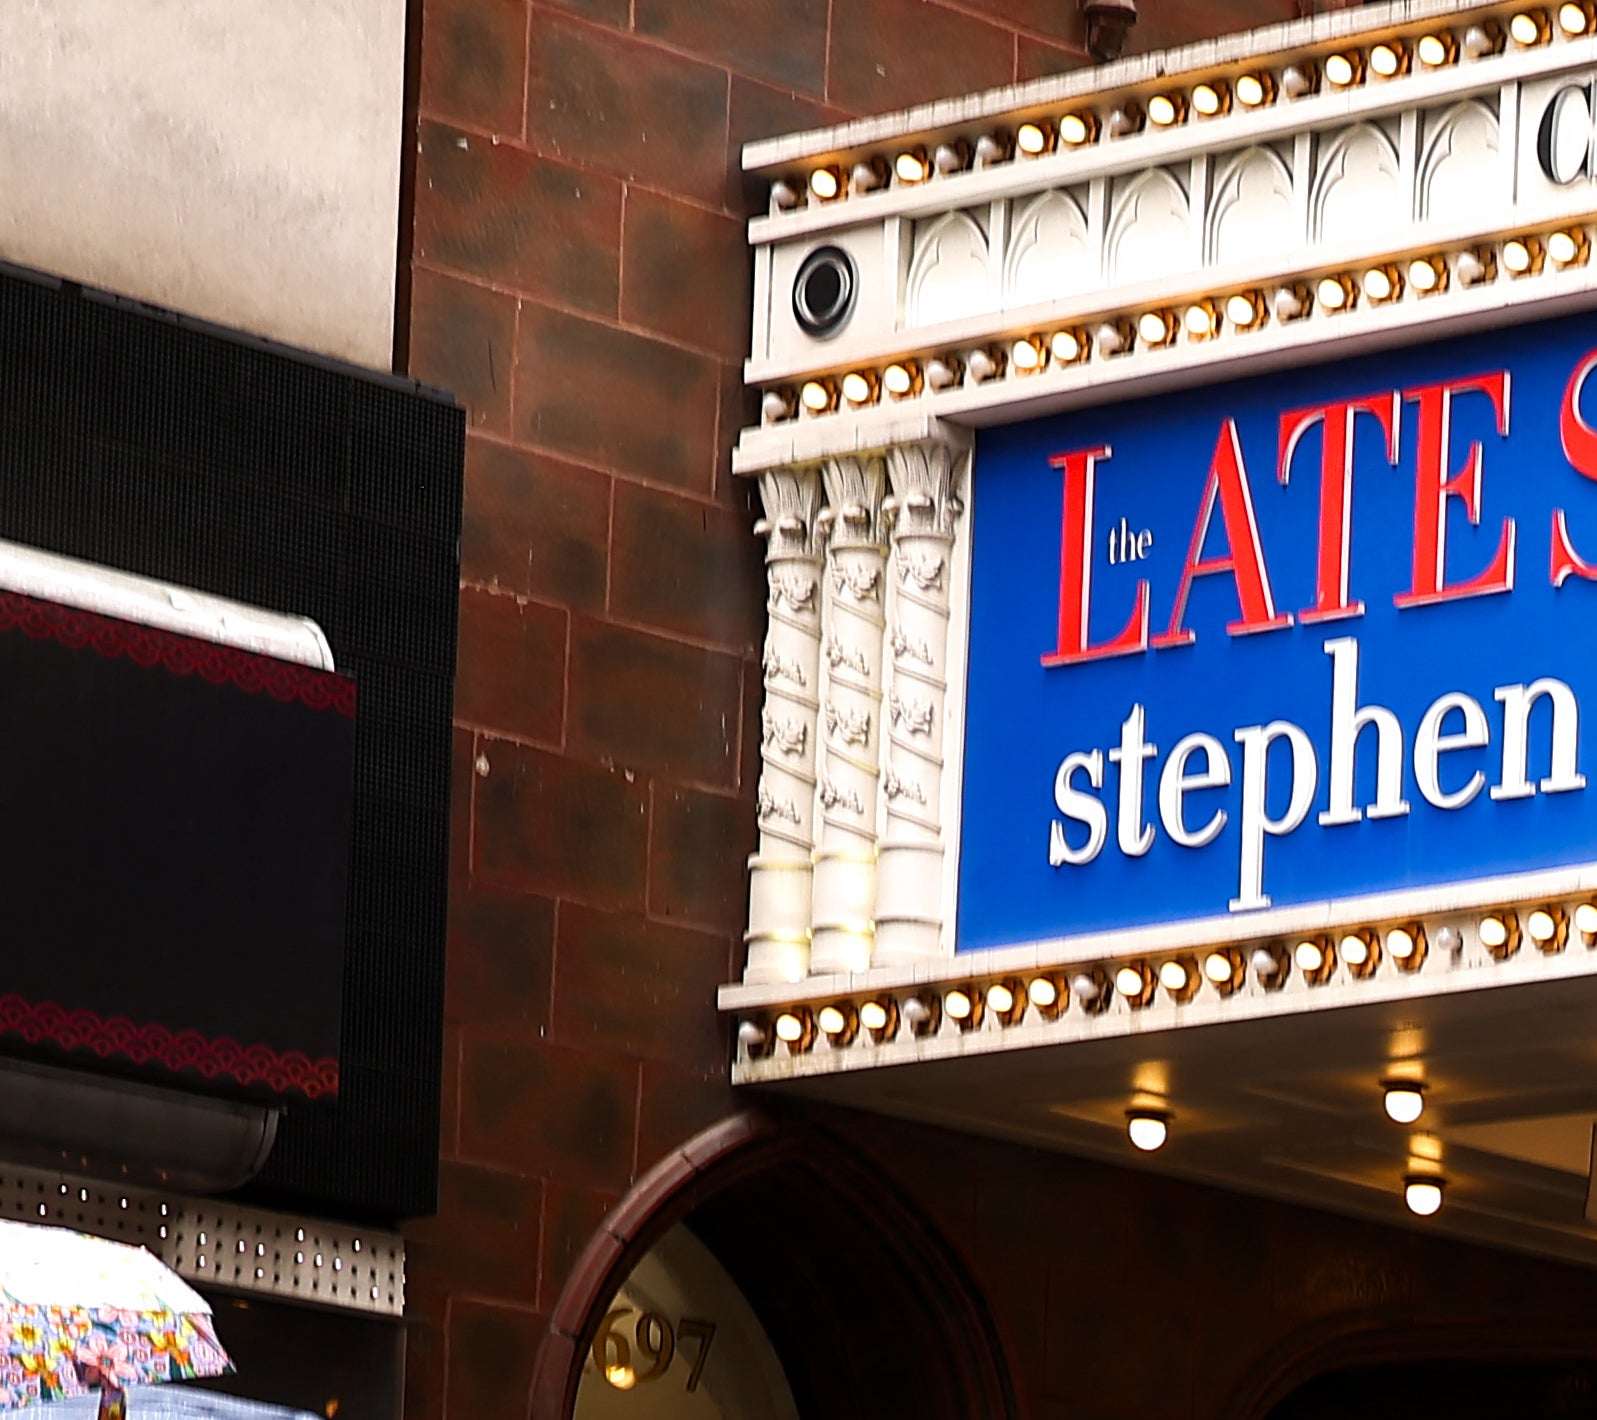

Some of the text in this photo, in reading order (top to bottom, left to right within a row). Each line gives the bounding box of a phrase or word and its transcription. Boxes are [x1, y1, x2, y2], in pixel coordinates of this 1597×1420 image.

[1041, 370, 1515, 667] LATE
[1107, 516, 1153, 566] the
[1049, 636, 1587, 911] stephen
[593, 1308, 717, 1393] 697
